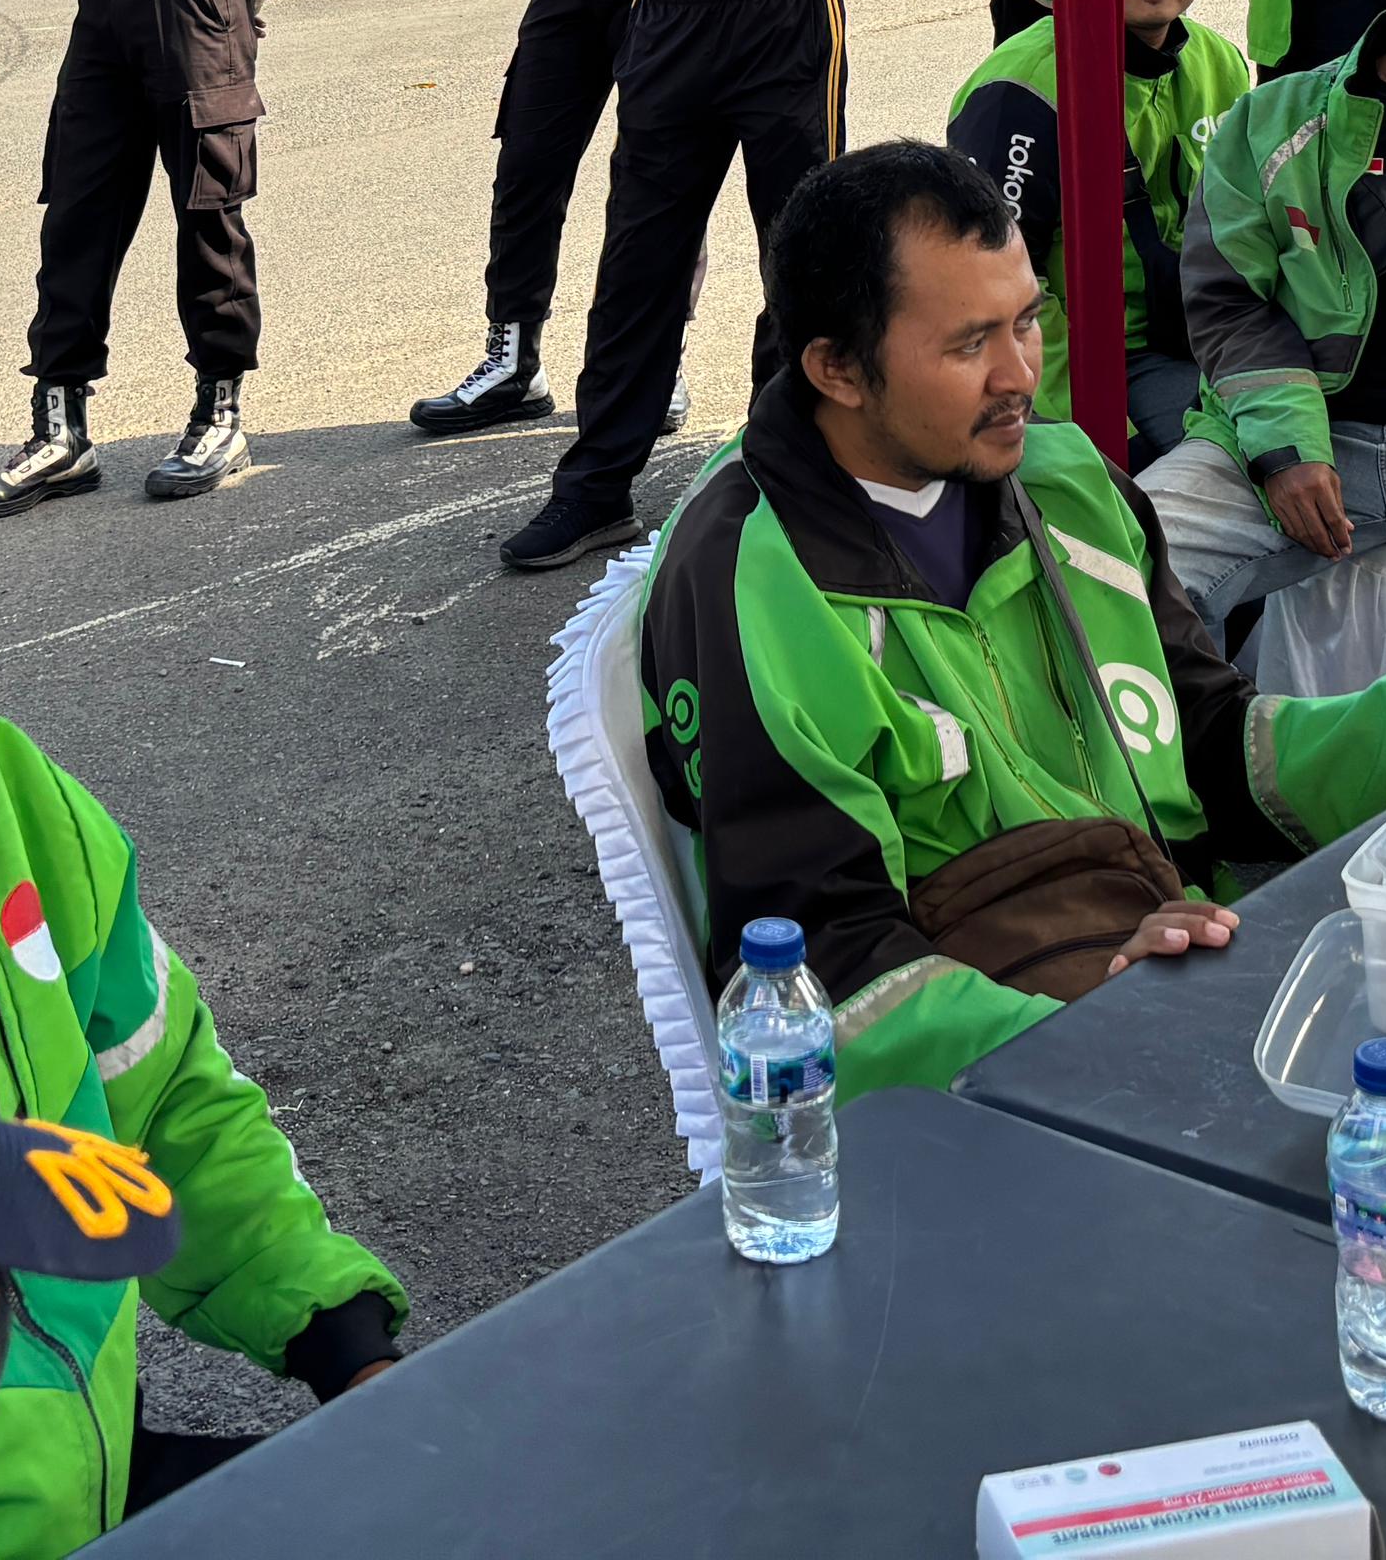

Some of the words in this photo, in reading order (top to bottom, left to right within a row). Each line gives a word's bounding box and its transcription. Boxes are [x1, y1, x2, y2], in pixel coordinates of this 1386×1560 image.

[1224, 1483, 1337, 1516] ATORVASTATIN
[1051, 1516, 1147, 1546] TRIHYDRATE
[1150, 1504, 1221, 1529] CALCIUM
